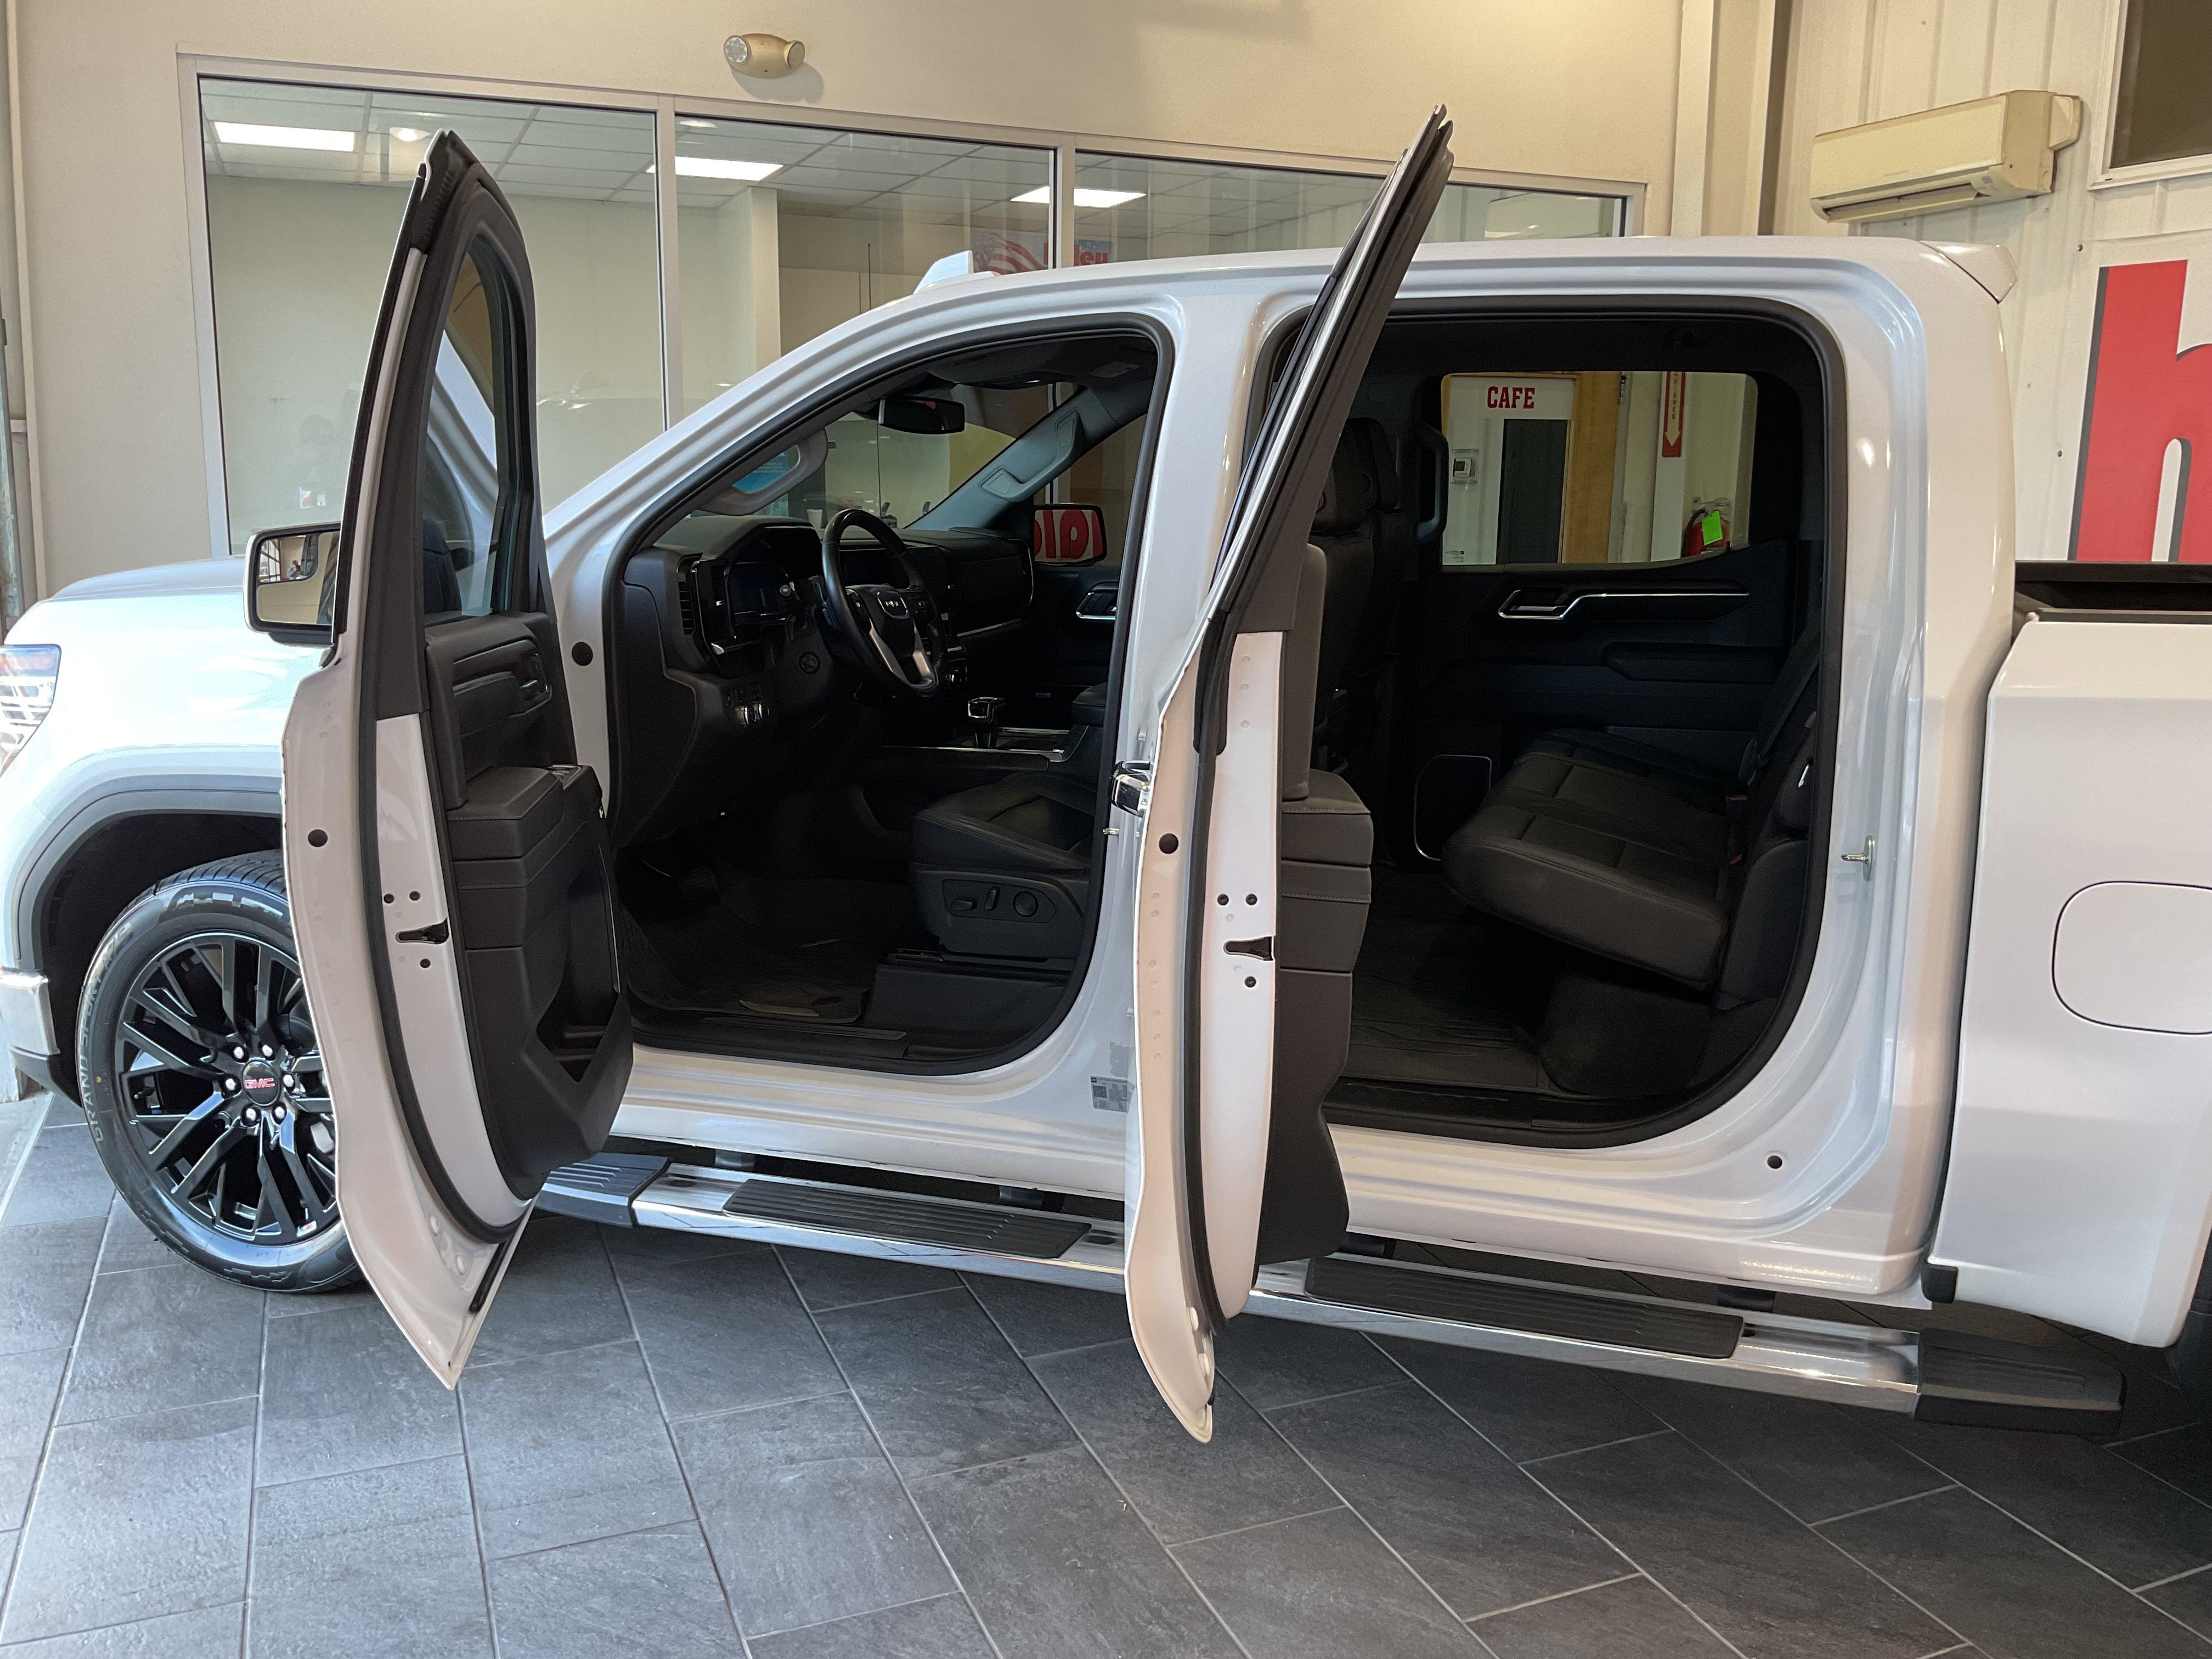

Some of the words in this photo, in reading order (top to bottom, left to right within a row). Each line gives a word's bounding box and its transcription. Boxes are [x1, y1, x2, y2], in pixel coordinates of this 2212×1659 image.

[1487, 386, 1535, 409] CAFE
[244, 1078, 275, 1089] GMC
[79, 1054, 103, 1142] GRAND
